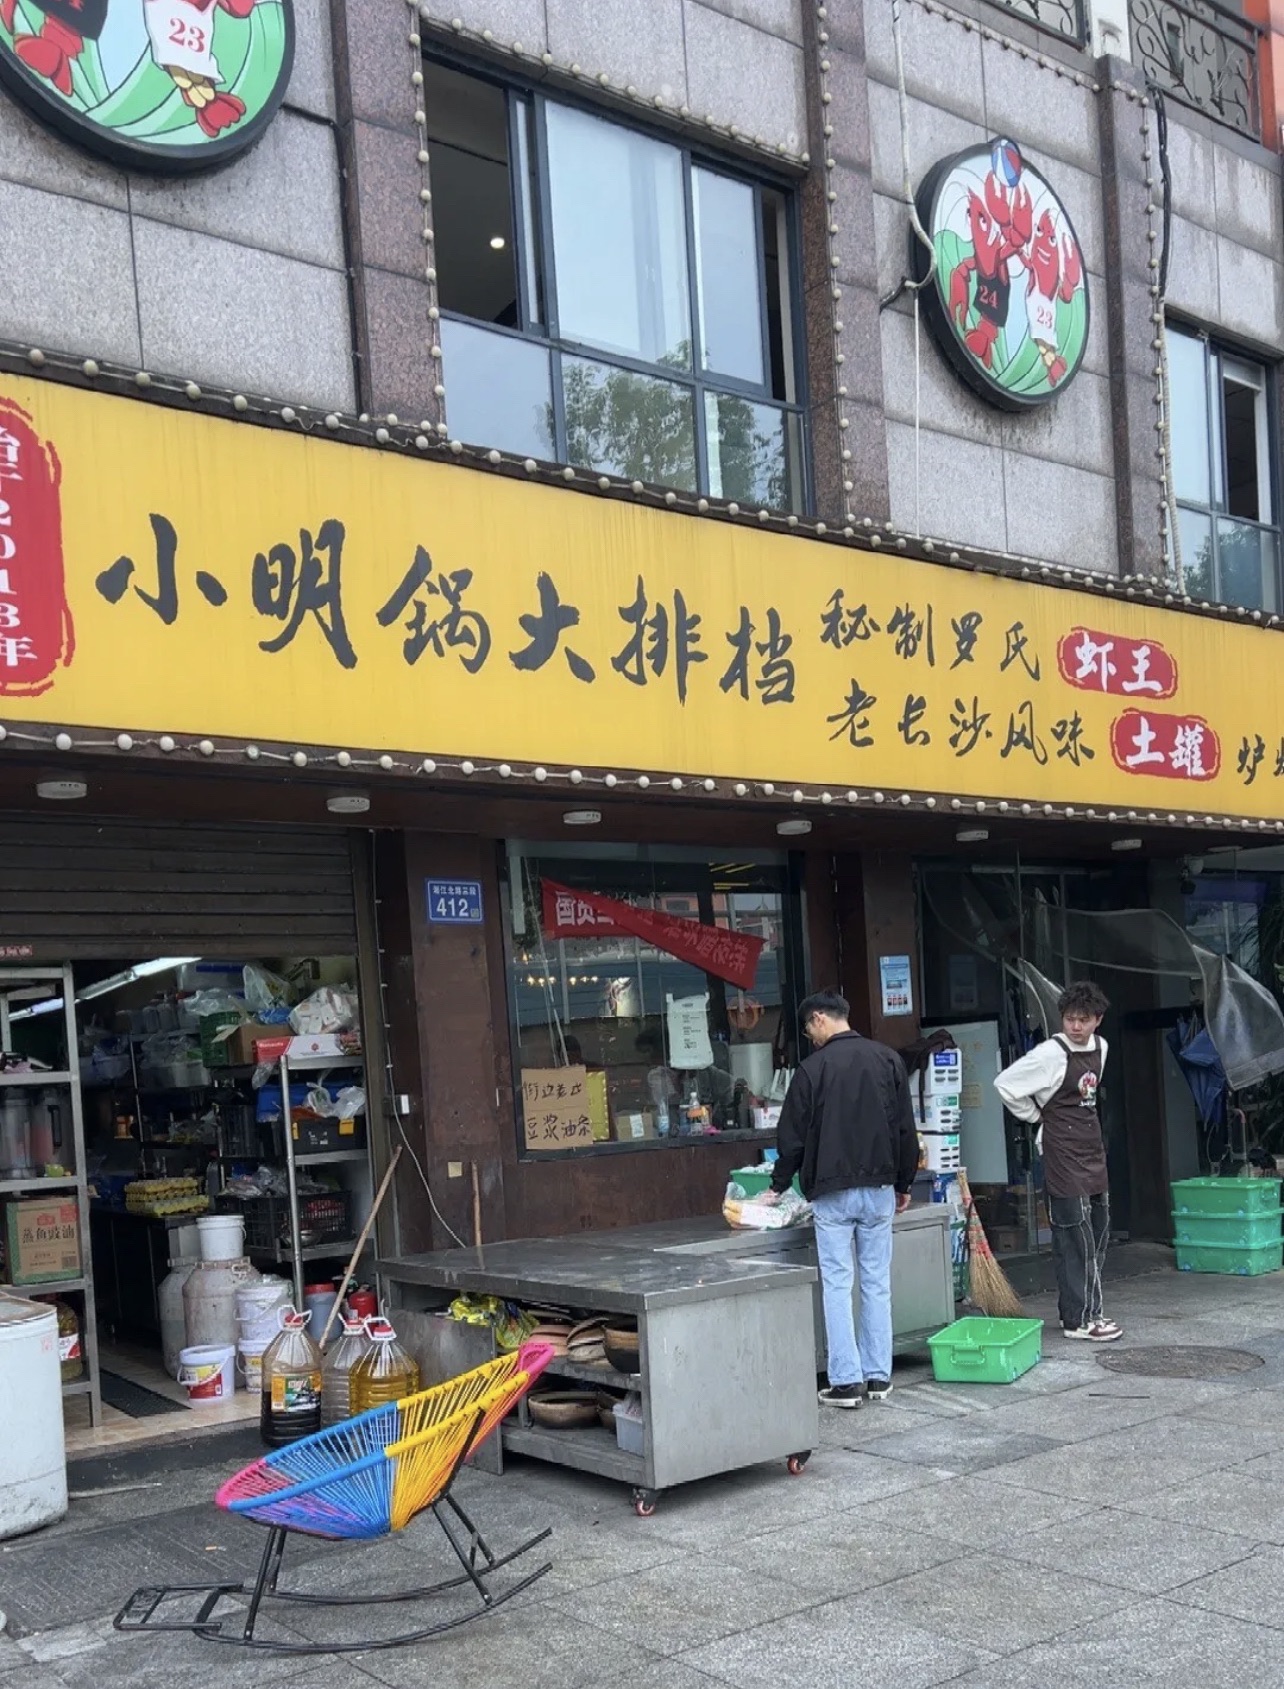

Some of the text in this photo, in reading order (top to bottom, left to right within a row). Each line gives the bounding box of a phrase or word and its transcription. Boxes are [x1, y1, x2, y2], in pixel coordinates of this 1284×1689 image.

[169, 17, 206, 53] 23
[979, 285, 998, 309] 24
[1036, 306, 1053, 328] 23
[819, 587, 1163, 693] 秘制罗氏 虾王
[827, 678, 1095, 768] 老长沙风味
[1125, 715, 1207, 777] 土罐
[436, 897, 469, 917] 412
[527, 1112, 591, 1141] 豆浆油条
